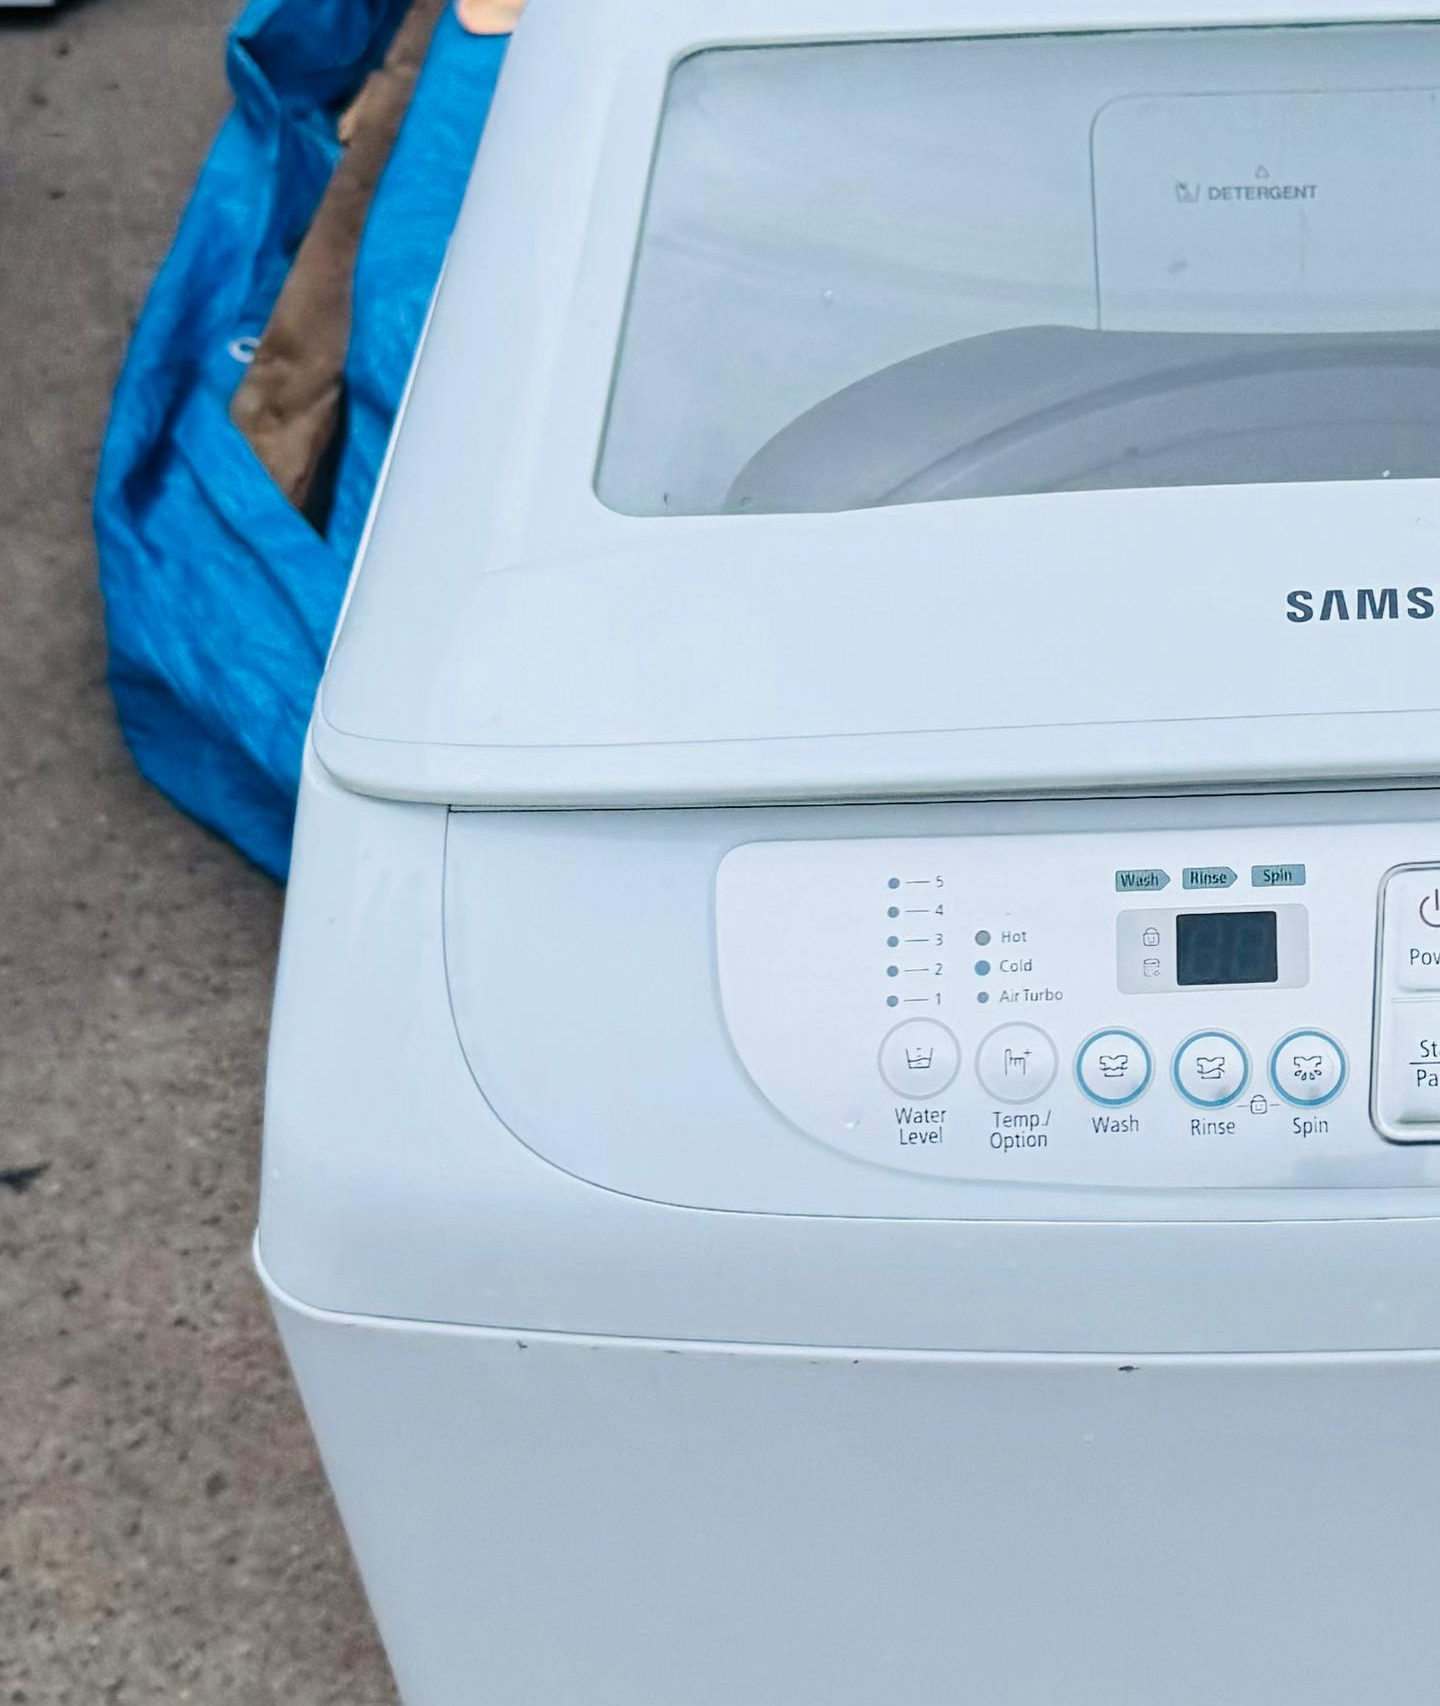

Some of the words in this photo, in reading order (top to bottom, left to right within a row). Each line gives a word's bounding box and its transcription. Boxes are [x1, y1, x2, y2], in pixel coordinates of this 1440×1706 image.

[1207, 184, 1318, 201] DETERGENT
[935, 875, 944, 888] 5
[1120, 872, 1160, 888] Wash
[1190, 870, 1228, 885] Rinse
[1263, 868, 1292, 886] Spin
[935, 904, 944, 916] 4
[935, 933, 944, 946] 3
[1001, 931, 1027, 943] Hot
[935, 962, 943, 976] 2
[999, 958, 1033, 973] Cold
[935, 992, 941, 1006] 1
[999, 989, 1020, 1003] Air
[1023, 987, 1064, 1002] Turbo
[894, 1107, 947, 1125] Water
[1091, 1114, 1140, 1134] Wash
[1190, 1118, 1236, 1135] Rinse
[1293, 1116, 1329, 1138] Spin
[899, 1126, 943, 1145] Level
[989, 1131, 1048, 1153] Option
